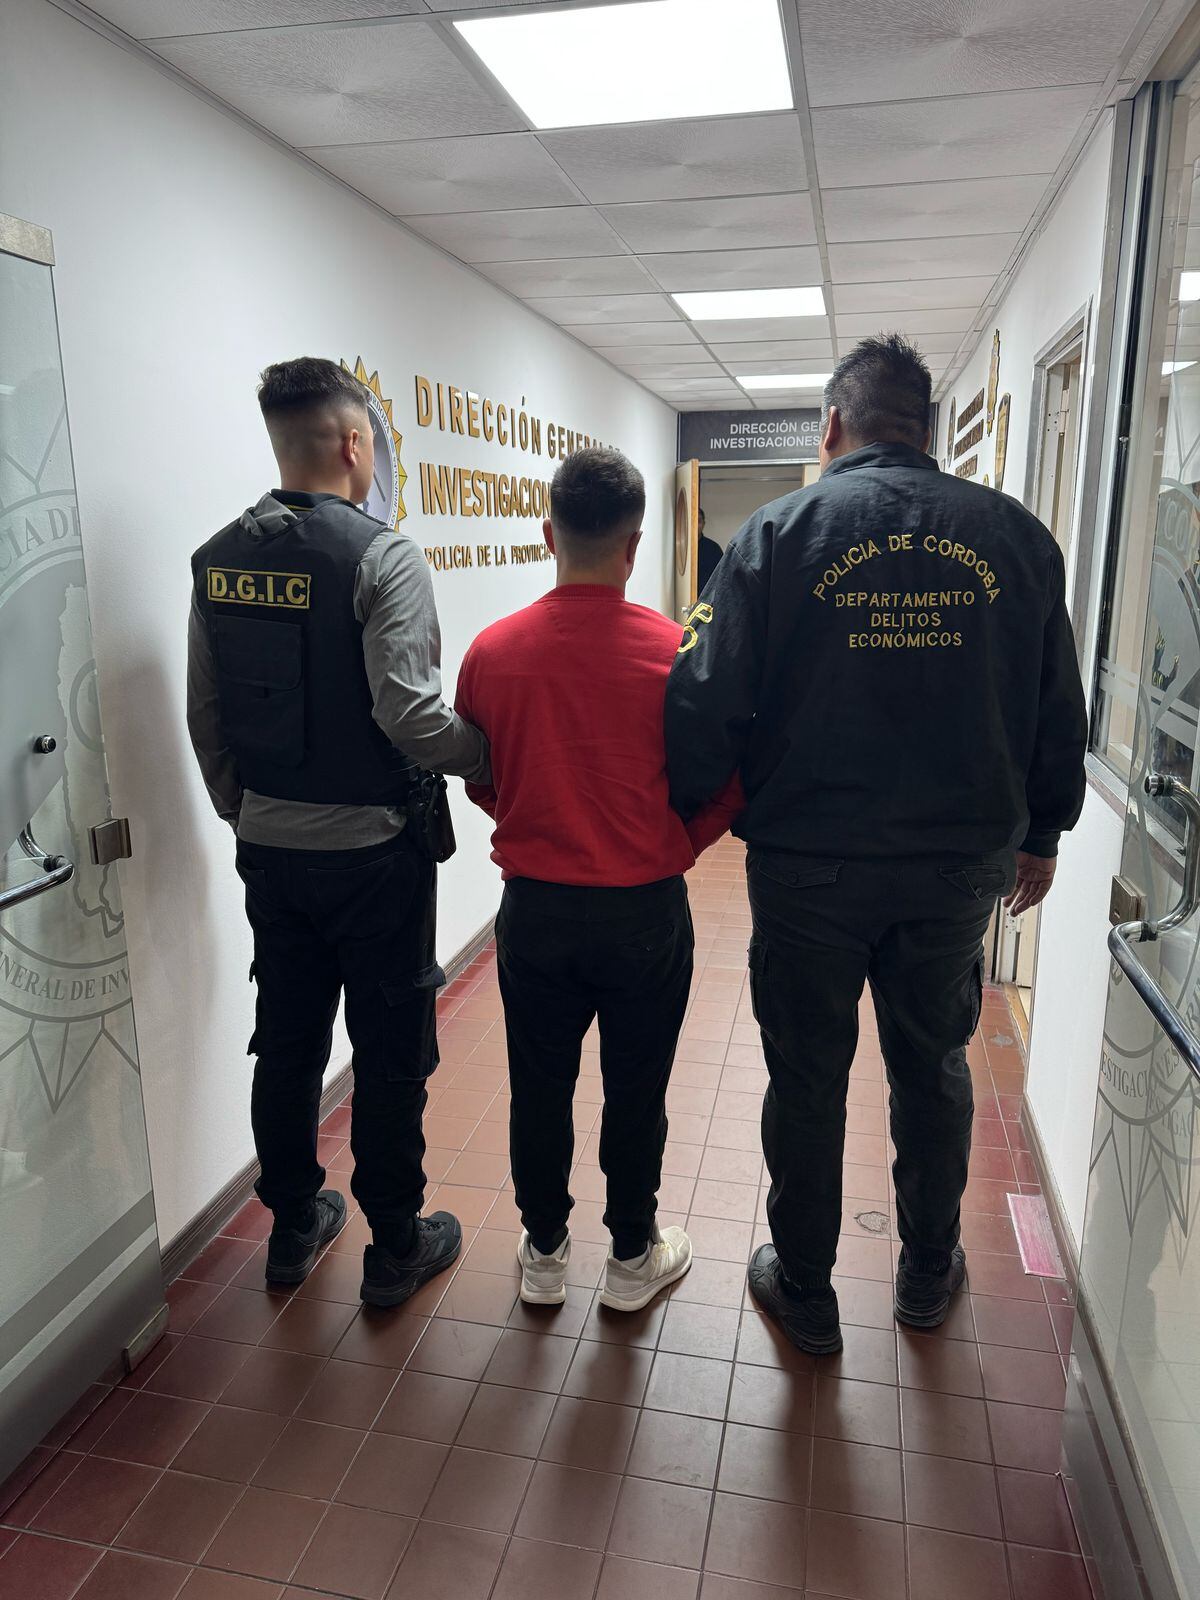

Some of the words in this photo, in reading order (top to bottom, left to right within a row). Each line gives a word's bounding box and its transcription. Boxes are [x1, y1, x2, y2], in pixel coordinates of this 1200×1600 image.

[414, 374, 542, 455] DIRECCIÓN
[547, 422, 602, 460] GENE
[730, 420, 797, 434] DIRECCIÓN
[710, 435, 820, 449] INVESTIGACIONES
[477, 545, 491, 567] DE
[494, 545, 507, 566] LA
[812, 540, 882, 601] POLICIA
[888, 533, 915, 551] DE
[923, 535, 1001, 605] CORDOBA
[210, 571, 306, 605] D.G.I.C
[835, 591, 975, 607] DEPARTAMENTO
[871, 612, 942, 628] DELITOS
[849, 628, 962, 648] ECONÓMICOS
[70, 979, 96, 1000] DE
